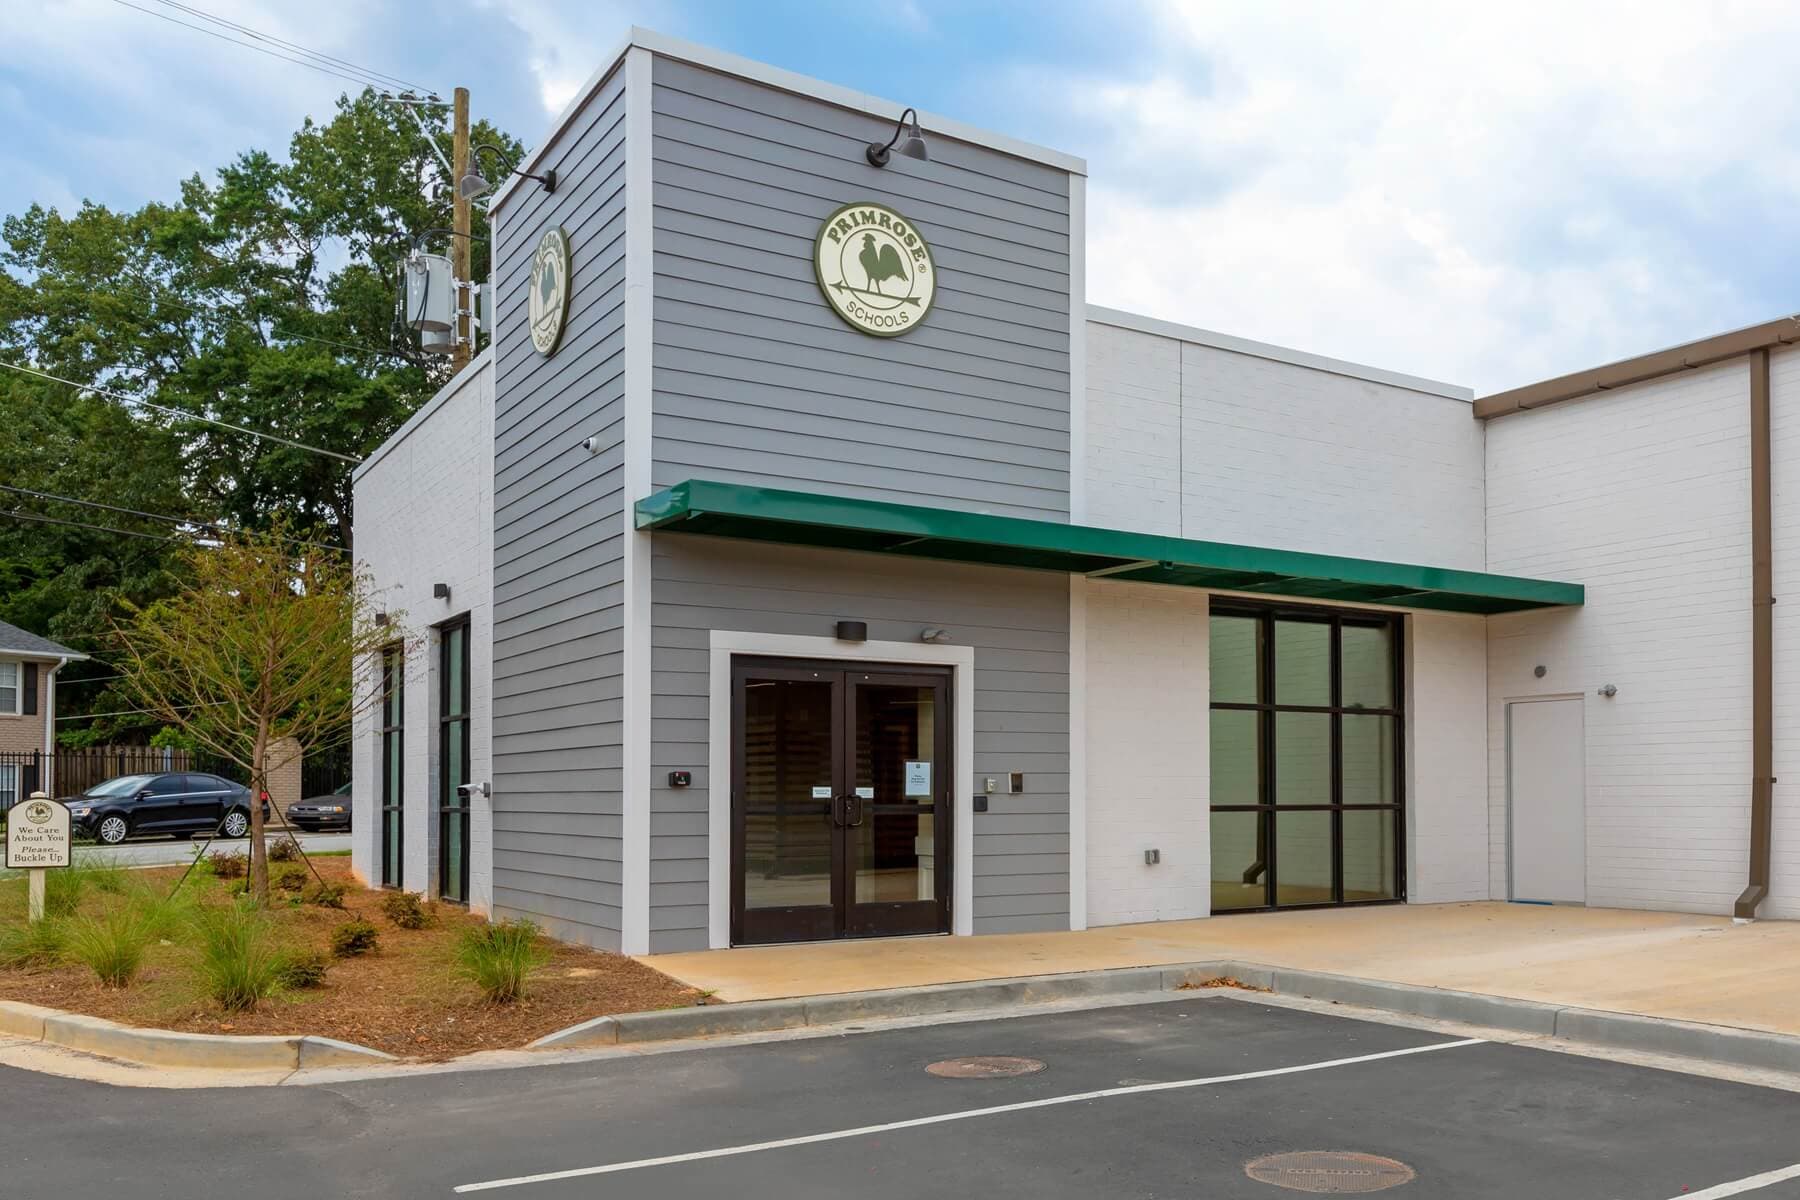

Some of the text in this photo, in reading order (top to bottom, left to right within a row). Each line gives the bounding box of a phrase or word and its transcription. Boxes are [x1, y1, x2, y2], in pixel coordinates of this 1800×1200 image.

[846, 301, 909, 327] SCHOOLS
[18, 826, 60, 834] We Care
[14, 834, 43, 842] About
[14, 853, 63, 863] Buckle Up
